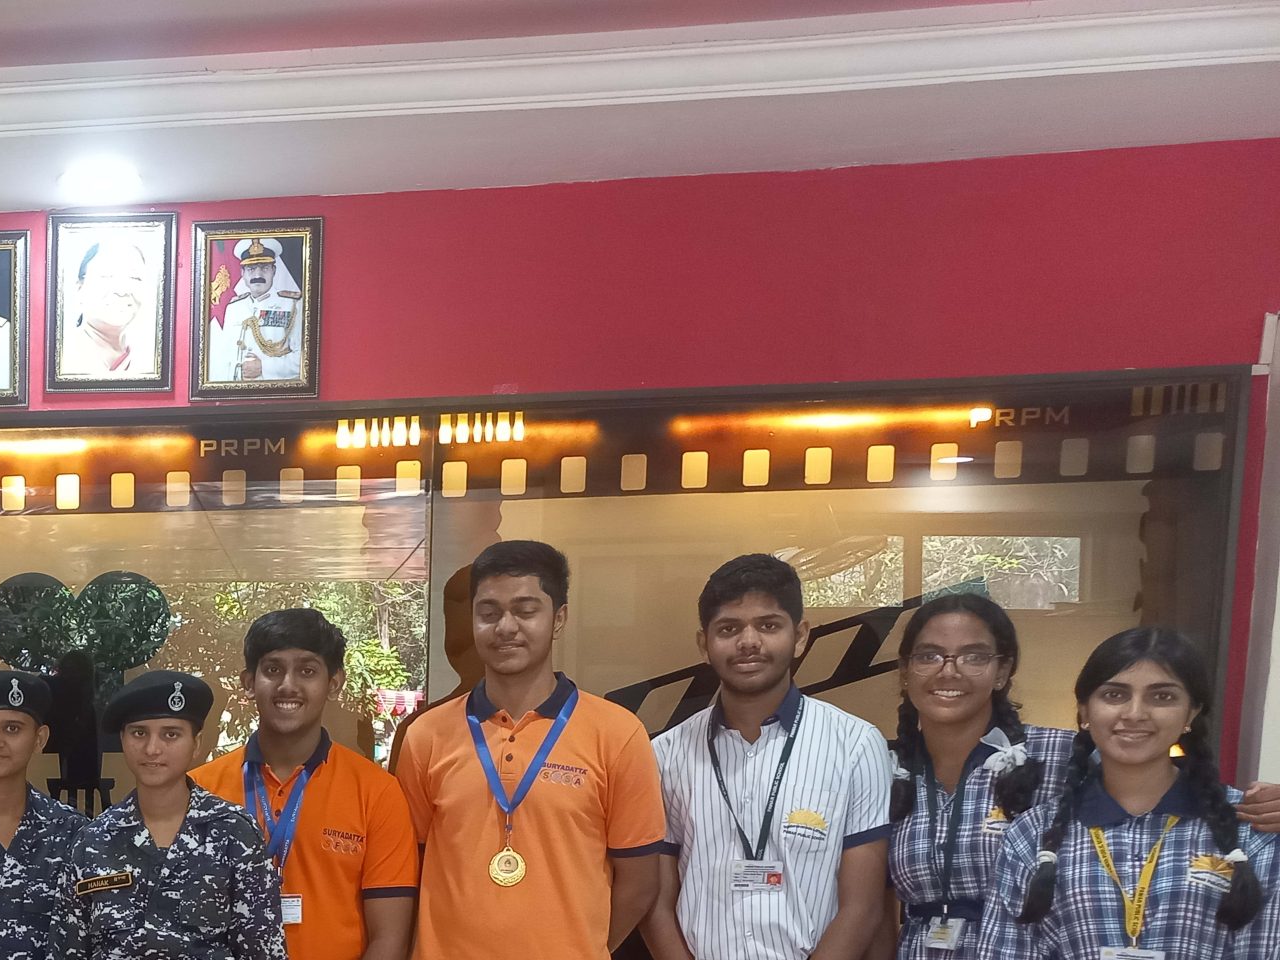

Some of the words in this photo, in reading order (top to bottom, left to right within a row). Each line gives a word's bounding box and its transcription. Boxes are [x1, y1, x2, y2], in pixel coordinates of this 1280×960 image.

[969, 405, 1070, 428] PRPM
[200, 437, 285, 457] PRPM
[322, 828, 364, 843] SURYADATTA
